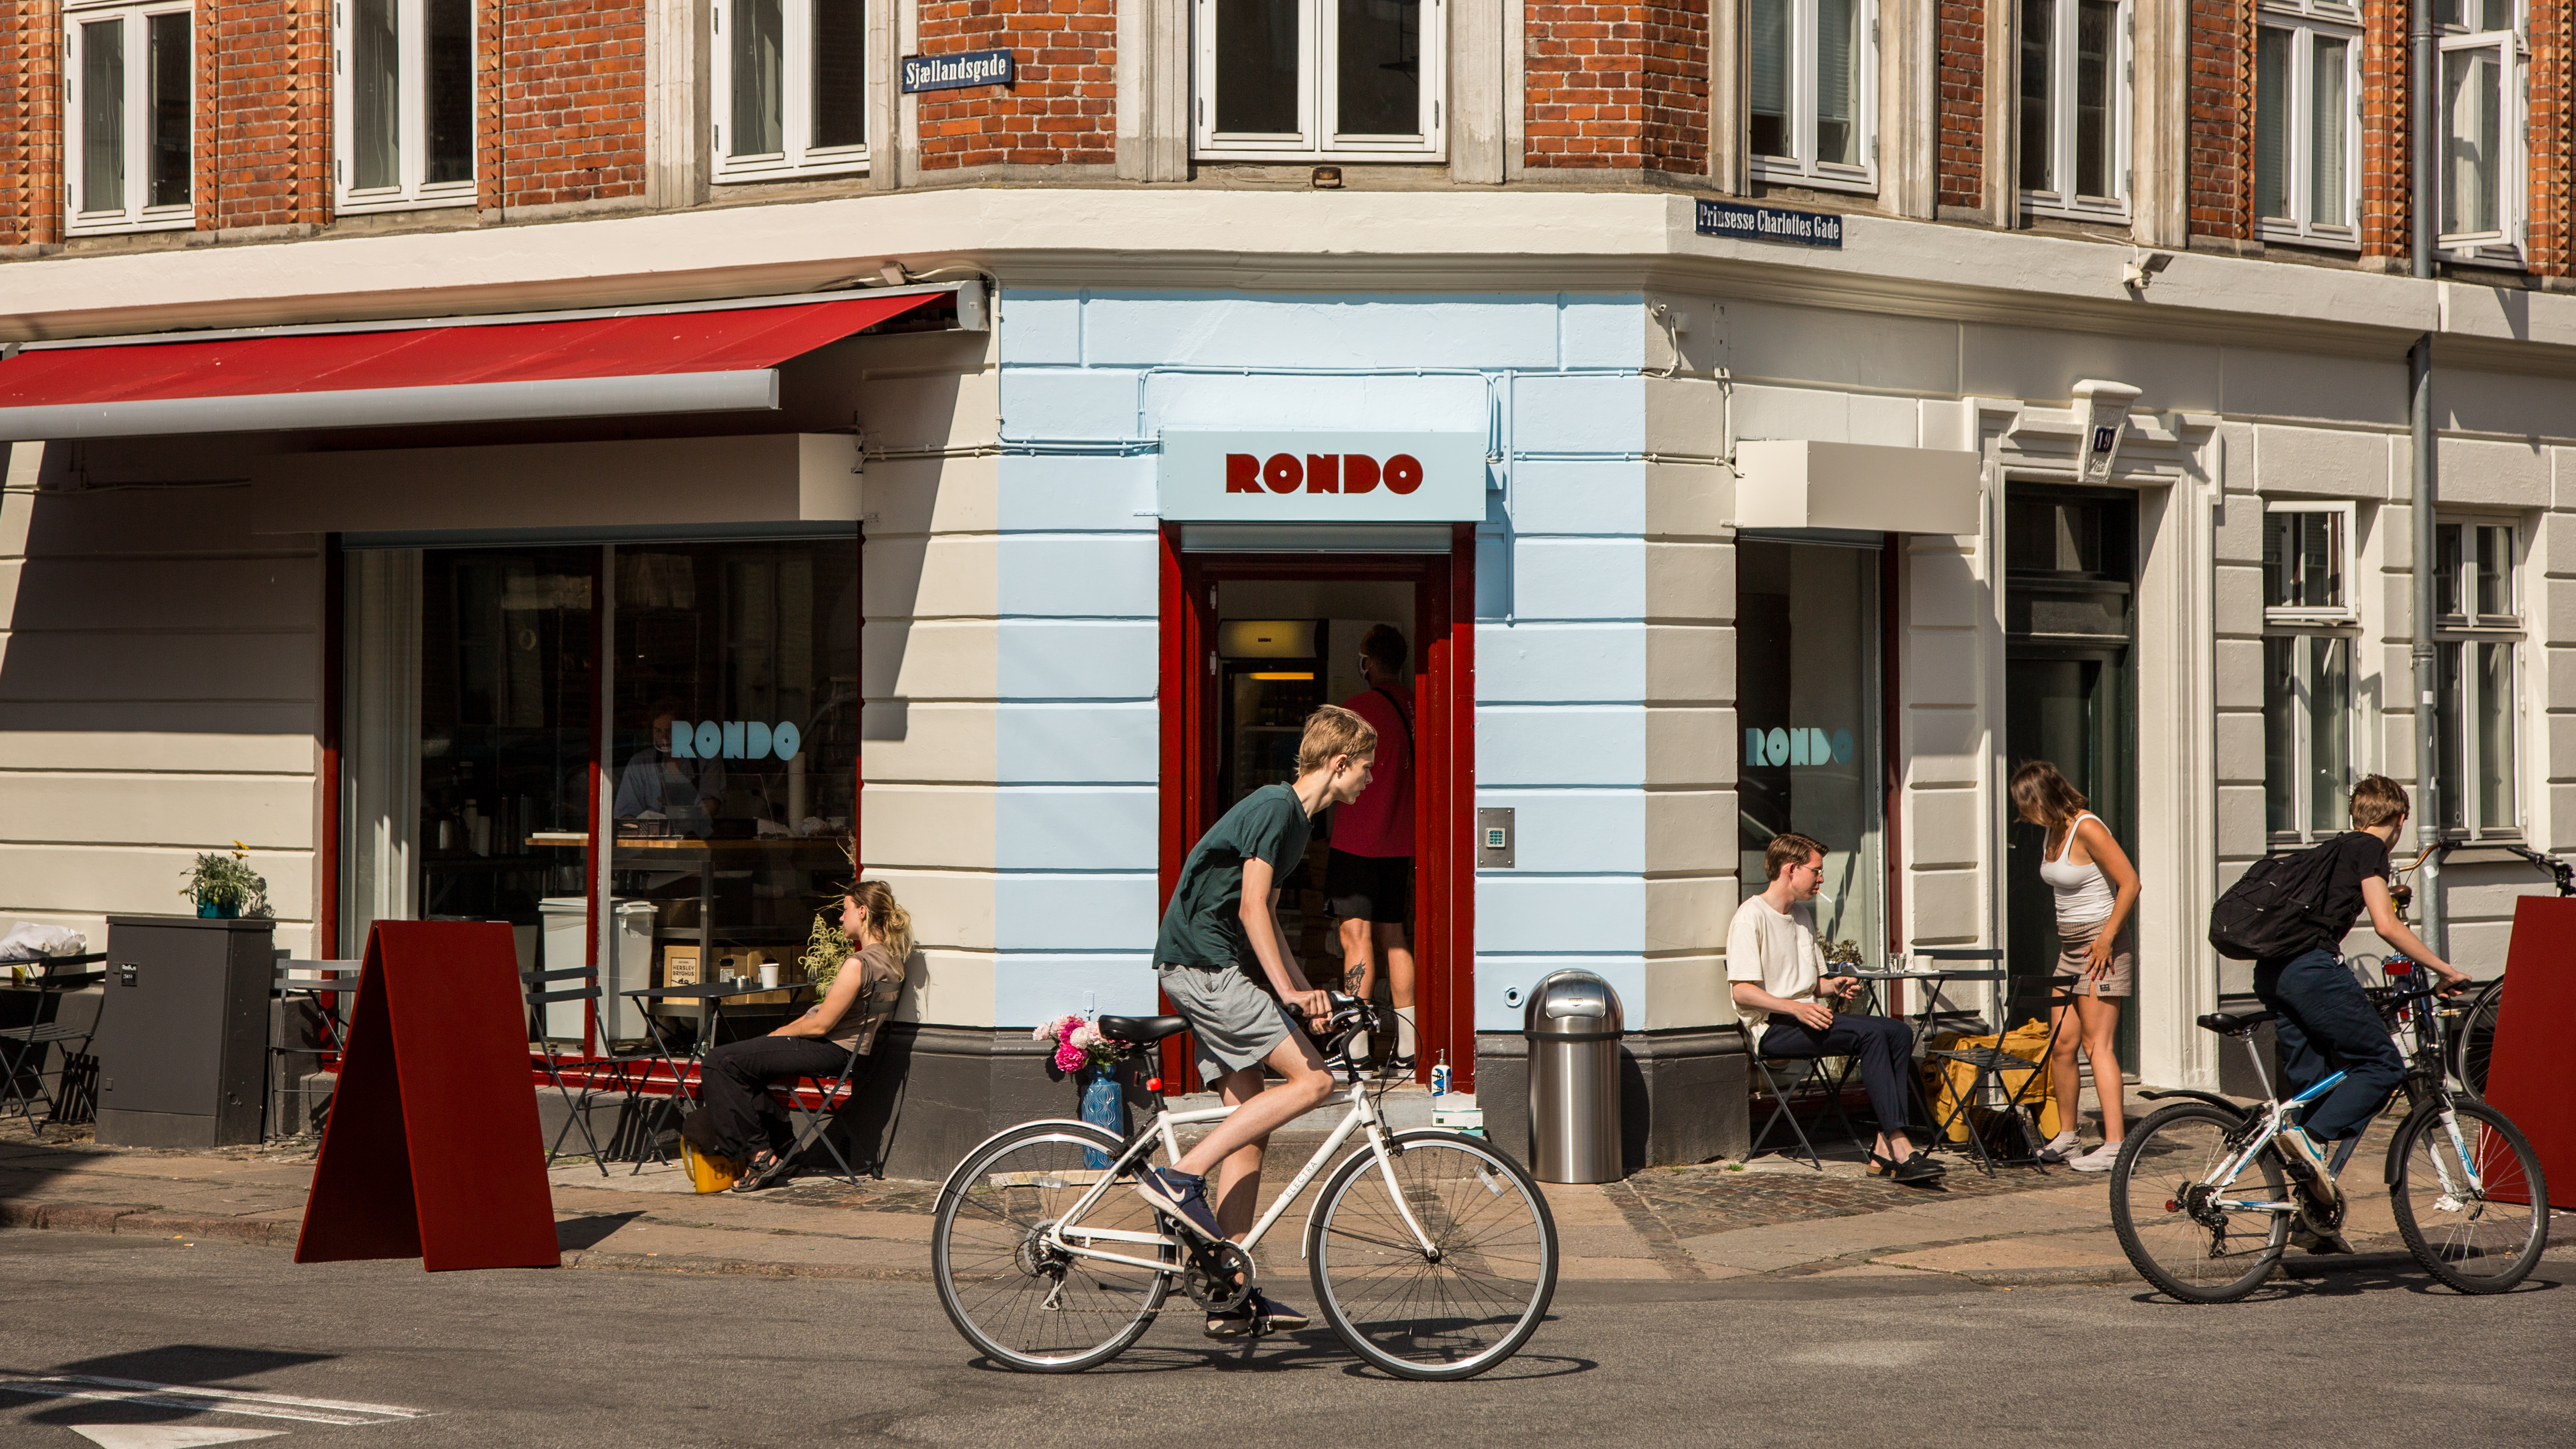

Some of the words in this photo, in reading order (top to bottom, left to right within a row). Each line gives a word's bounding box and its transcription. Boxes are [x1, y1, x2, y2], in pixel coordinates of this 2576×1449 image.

[906, 53, 1006, 90] Sjællandsgade
[1699, 204, 1755, 231] Prinsesse
[1757, 210, 1812, 237] Charlottes
[1814, 216, 1839, 240] Gade
[2097, 431, 2111, 449] 19
[1226, 452, 1424, 495] RONDO
[671, 720, 800, 761] RONDO
[1745, 727, 1854, 767] RONDO
[1285, 1162, 1318, 1198] ELECTRA
